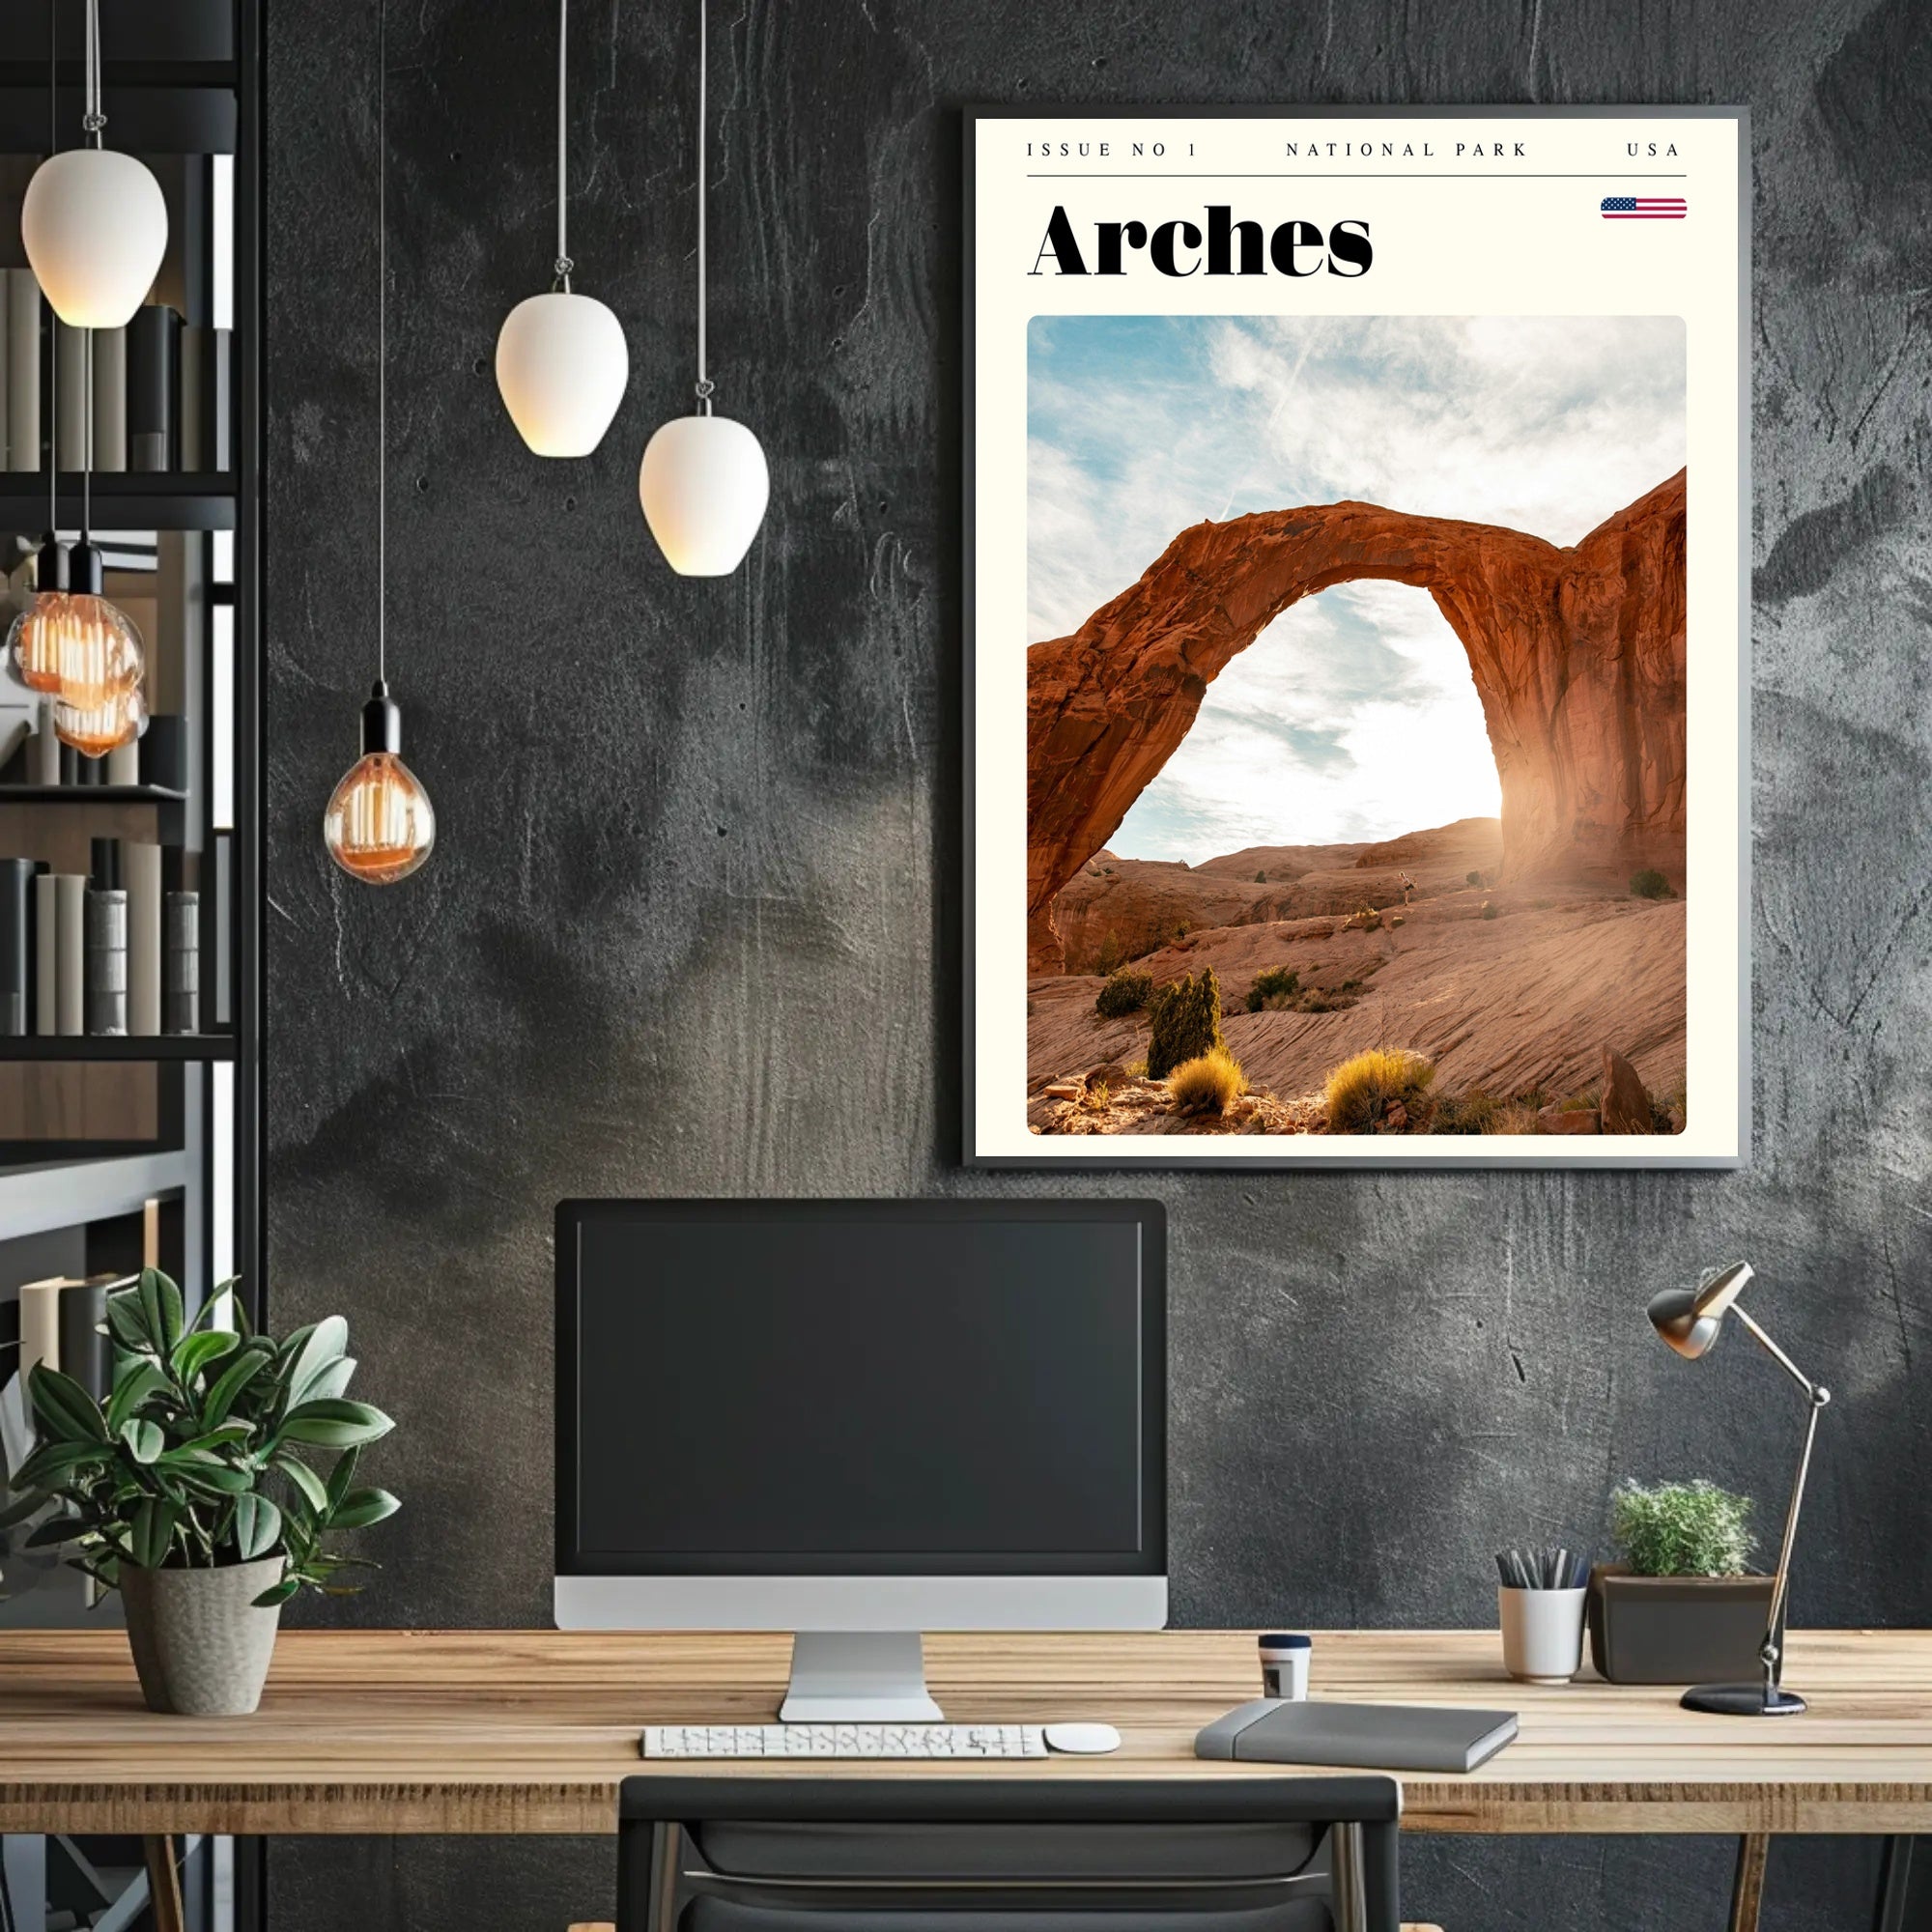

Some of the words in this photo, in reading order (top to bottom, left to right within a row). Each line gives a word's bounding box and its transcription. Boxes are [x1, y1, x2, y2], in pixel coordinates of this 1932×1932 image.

[1026, 142, 1111, 157] ISSUE
[1131, 142, 1166, 157] NO
[1188, 143, 1195, 156] 1
[1286, 142, 1435, 157] NATIONAL
[1456, 142, 1527, 157] PARK
[1626, 142, 1680, 157] USA
[1027, 205, 1374, 278] Arches
